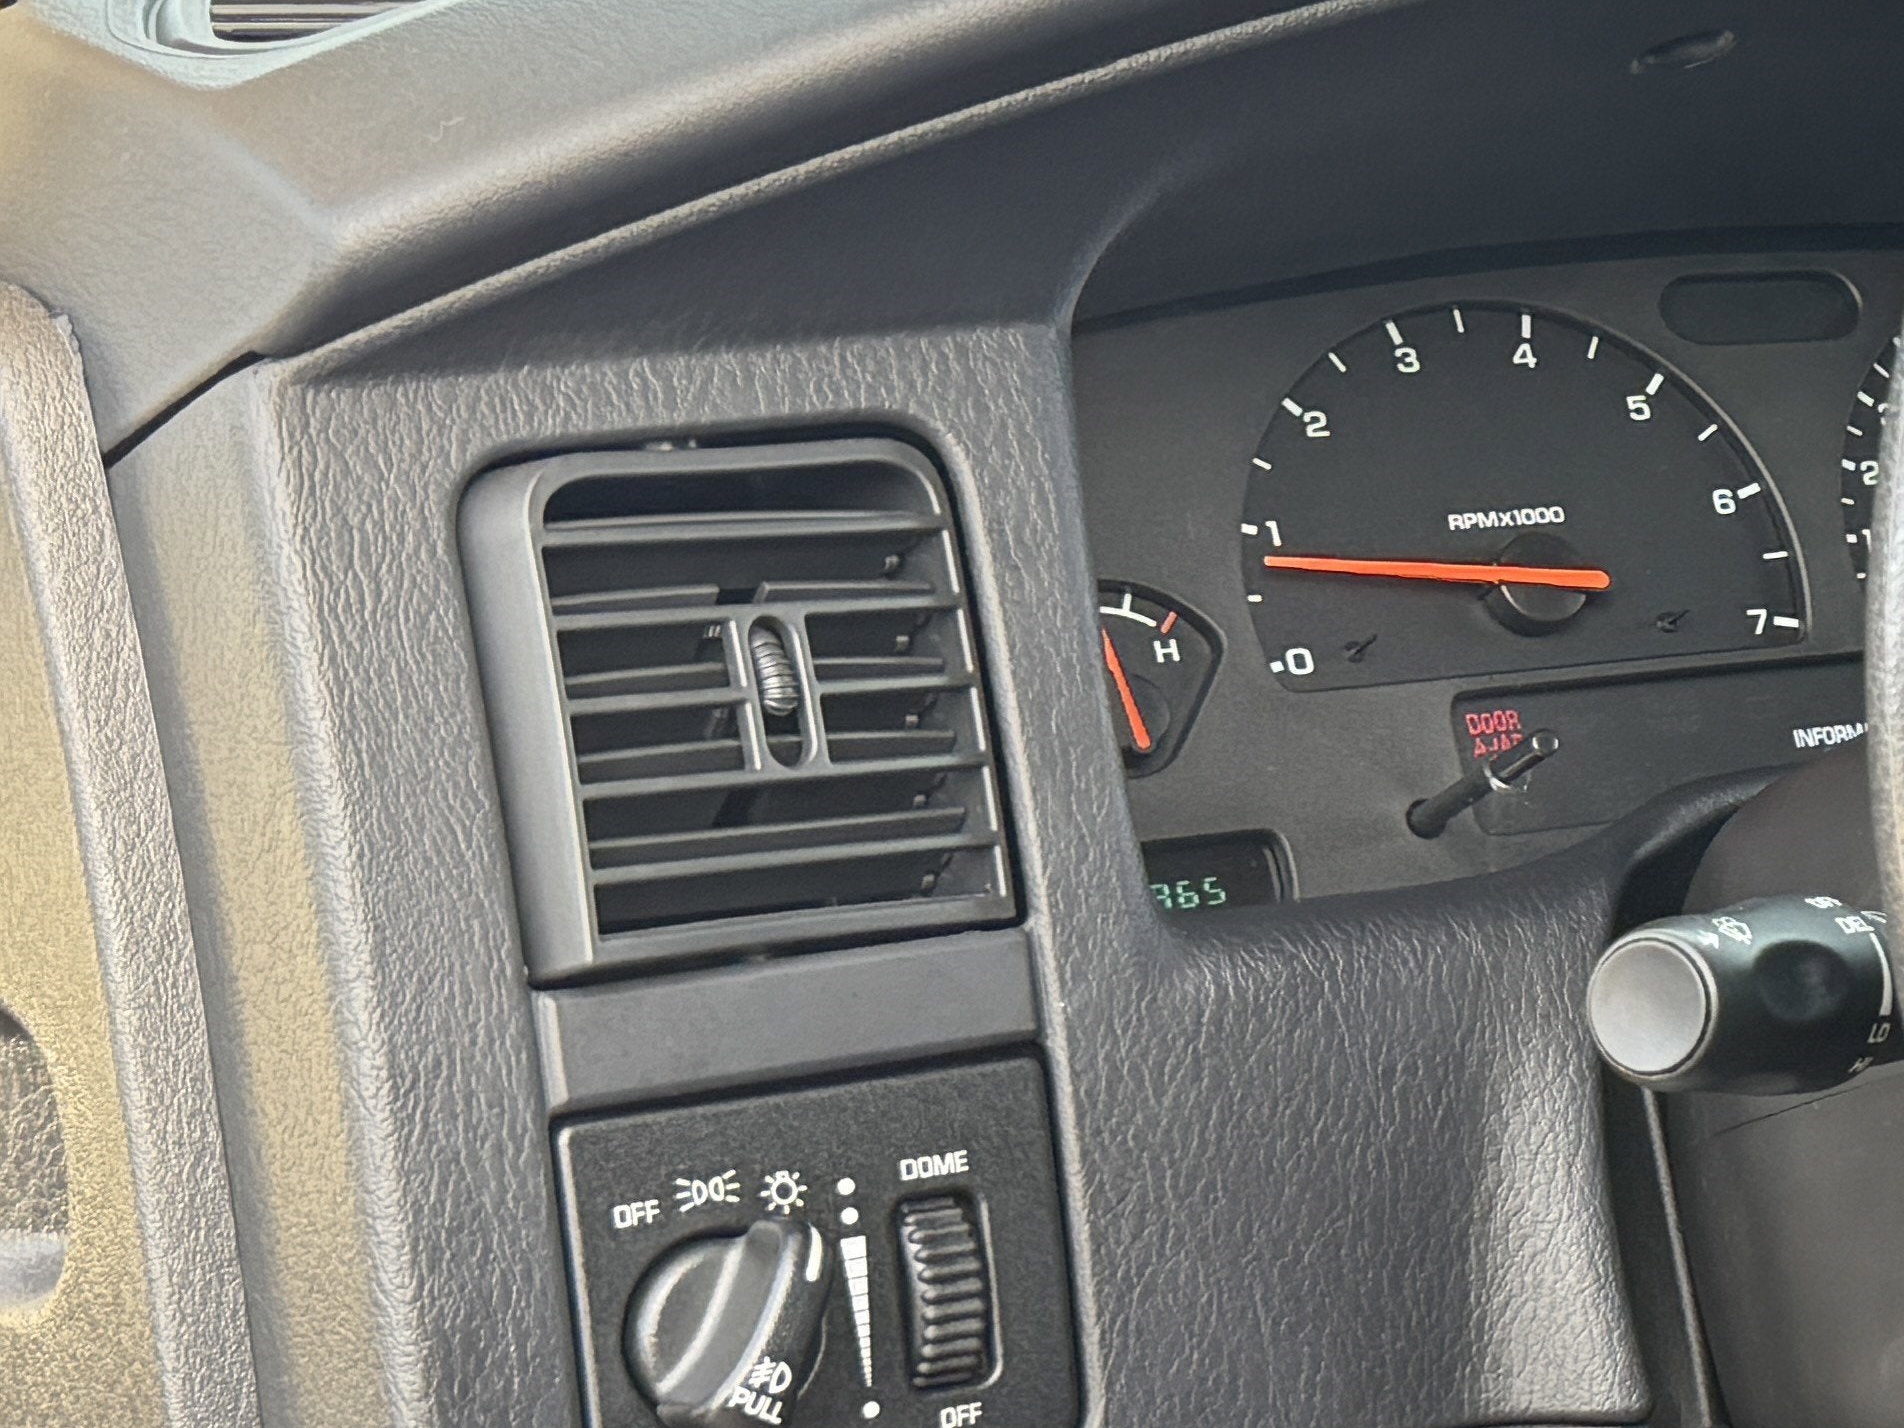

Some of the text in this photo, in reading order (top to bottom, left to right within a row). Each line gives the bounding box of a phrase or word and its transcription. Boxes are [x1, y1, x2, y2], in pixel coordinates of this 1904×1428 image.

[1395, 346, 1421, 373] 3
[1512, 342, 1538, 369] 4
[1626, 394, 1652, 421] 5
[1303, 410, 1331, 438] 2
[1711, 488, 1737, 515] 6
[1264, 520, 1283, 548] 1
[1746, 608, 1768, 635] 7
[1153, 638, 1181, 665] H
[1287, 647, 1316, 677] 0
[1465, 710, 1521, 735] DOOR
[1793, 721, 1868, 749] INFORM
[899, 1149, 970, 1182] DOME
[612, 1198, 662, 1230] OFF
[728, 1385, 784, 1426] PULL
